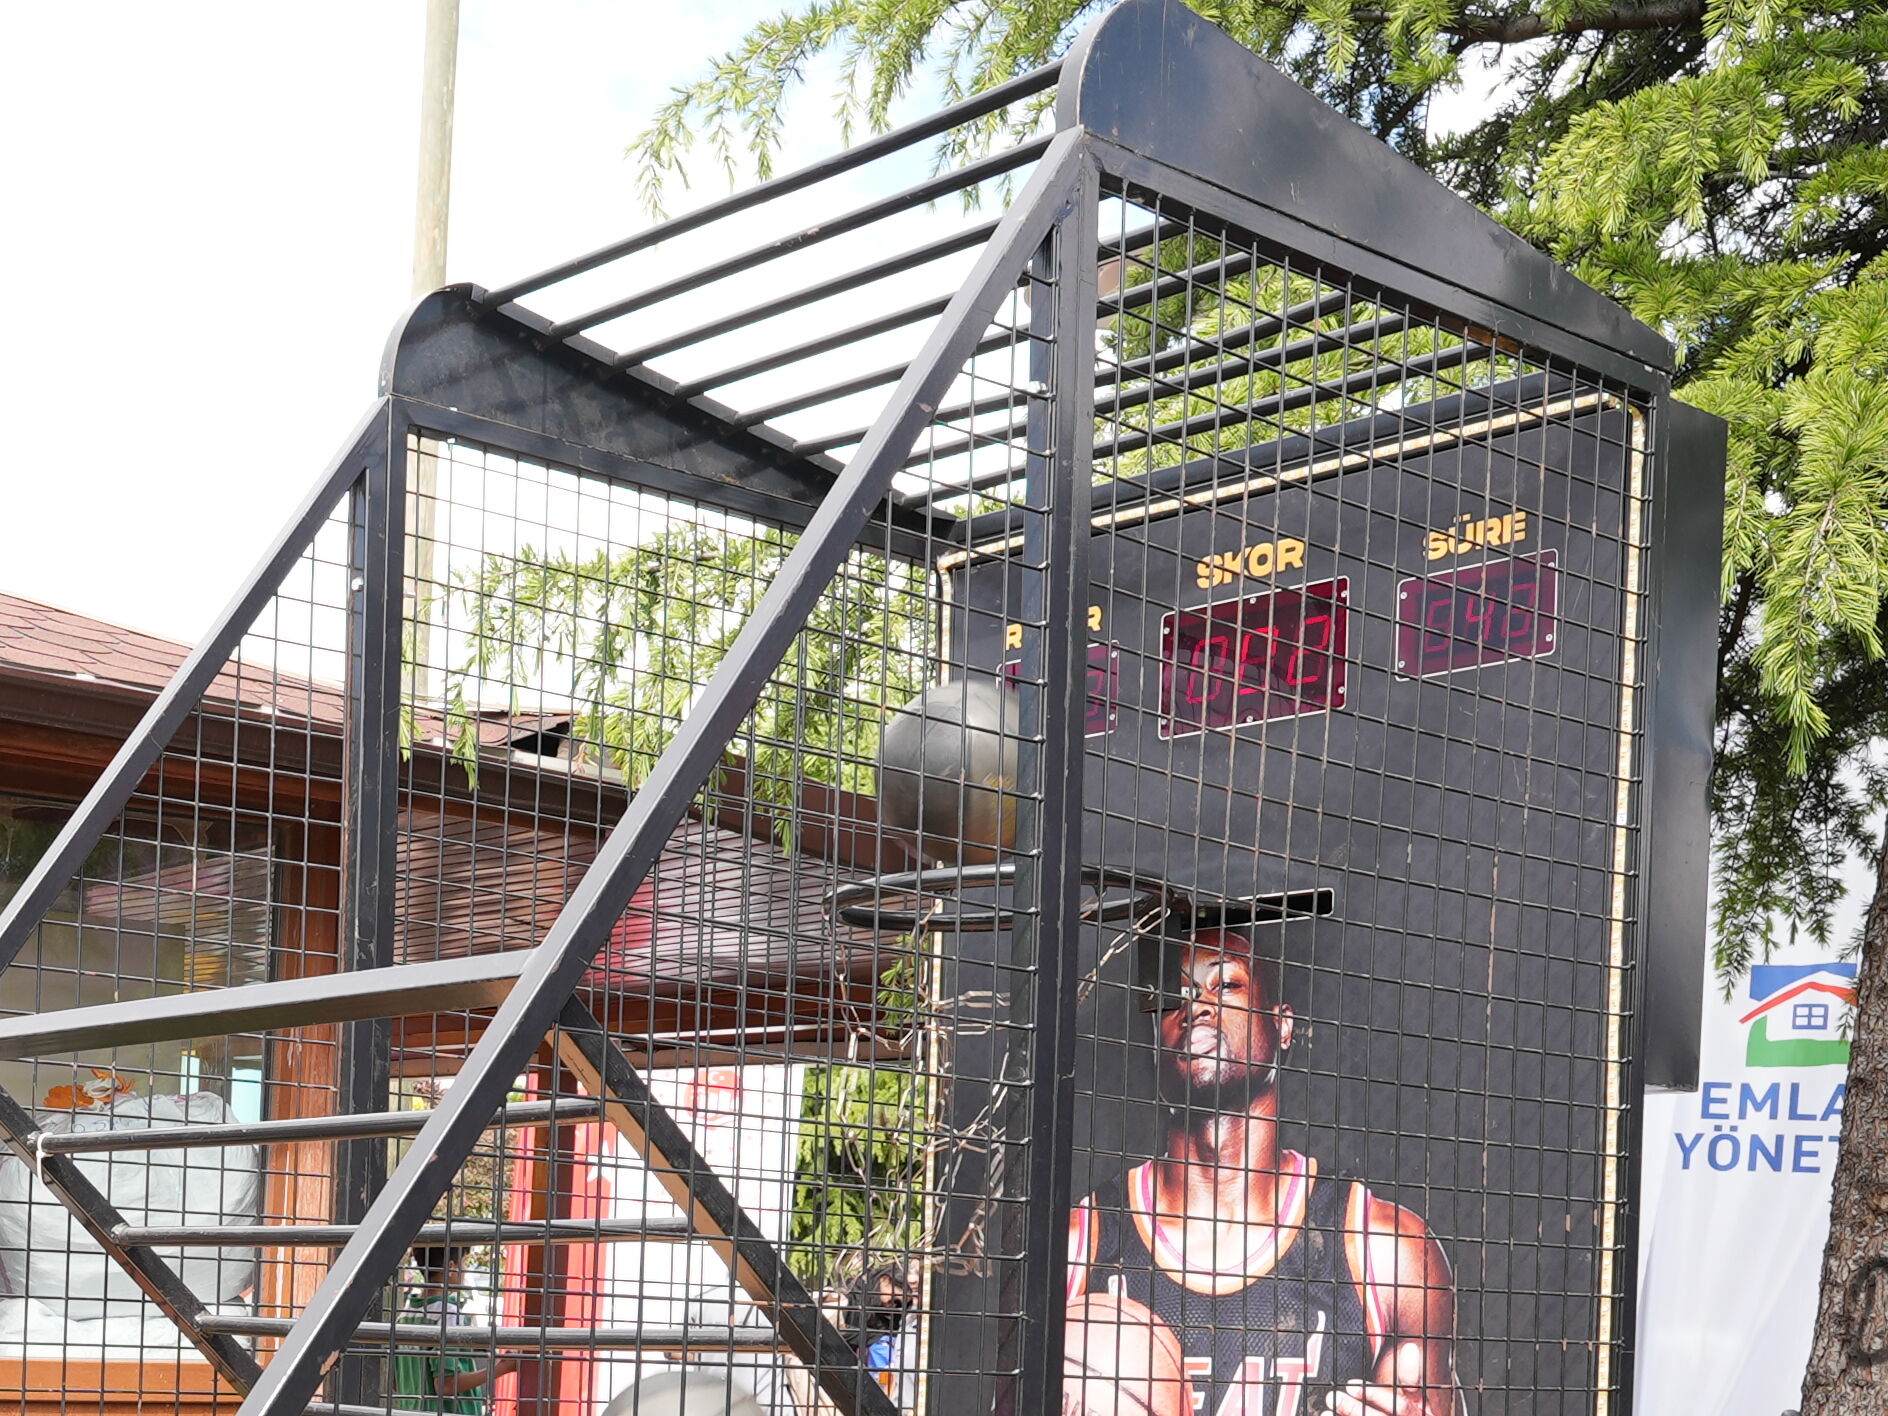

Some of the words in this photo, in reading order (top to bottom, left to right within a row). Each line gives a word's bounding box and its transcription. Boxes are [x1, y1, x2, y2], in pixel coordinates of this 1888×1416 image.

[1423, 512, 1526, 560] SÜRE
[1196, 538, 1305, 588] SKOR
[1701, 1082, 1847, 1121] EMLA
